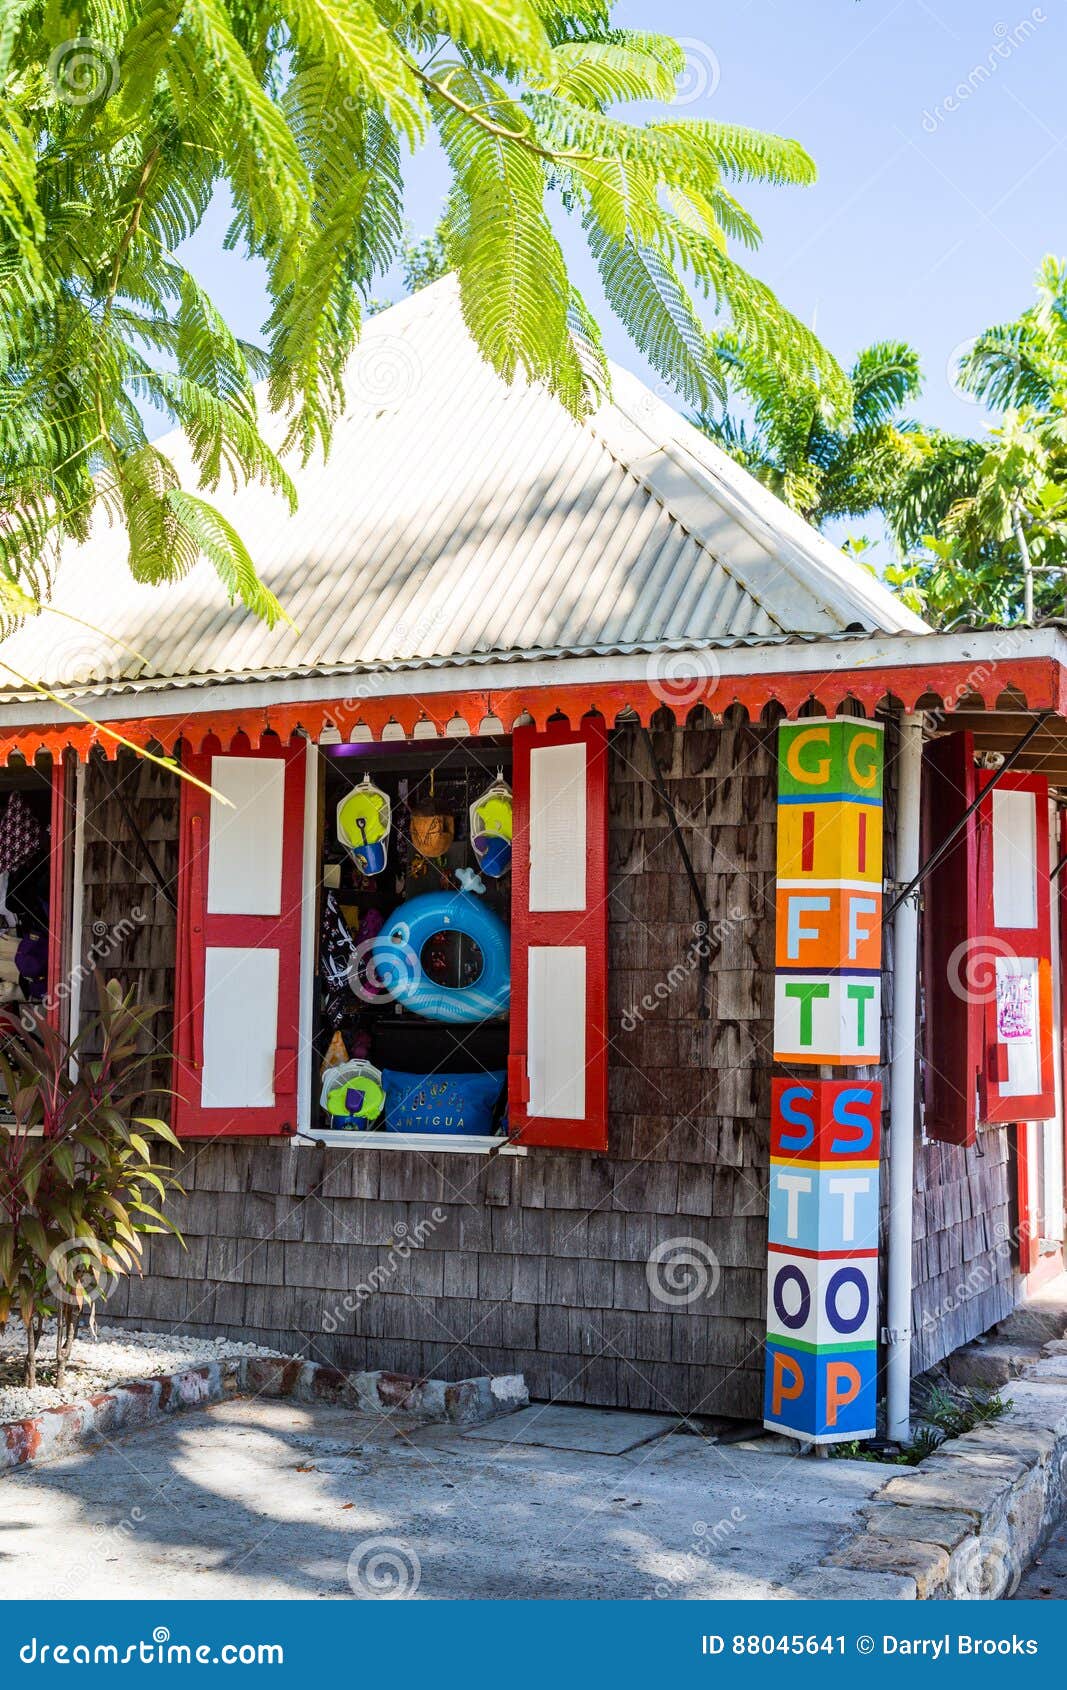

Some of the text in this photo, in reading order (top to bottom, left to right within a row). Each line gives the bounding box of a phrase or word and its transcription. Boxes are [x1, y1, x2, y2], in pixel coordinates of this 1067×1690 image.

[396, 1115, 465, 1128] ANTIGUA
[771, 727, 833, 1417] GIFT STOP
[824, 732, 878, 1427] GIFT STOP
